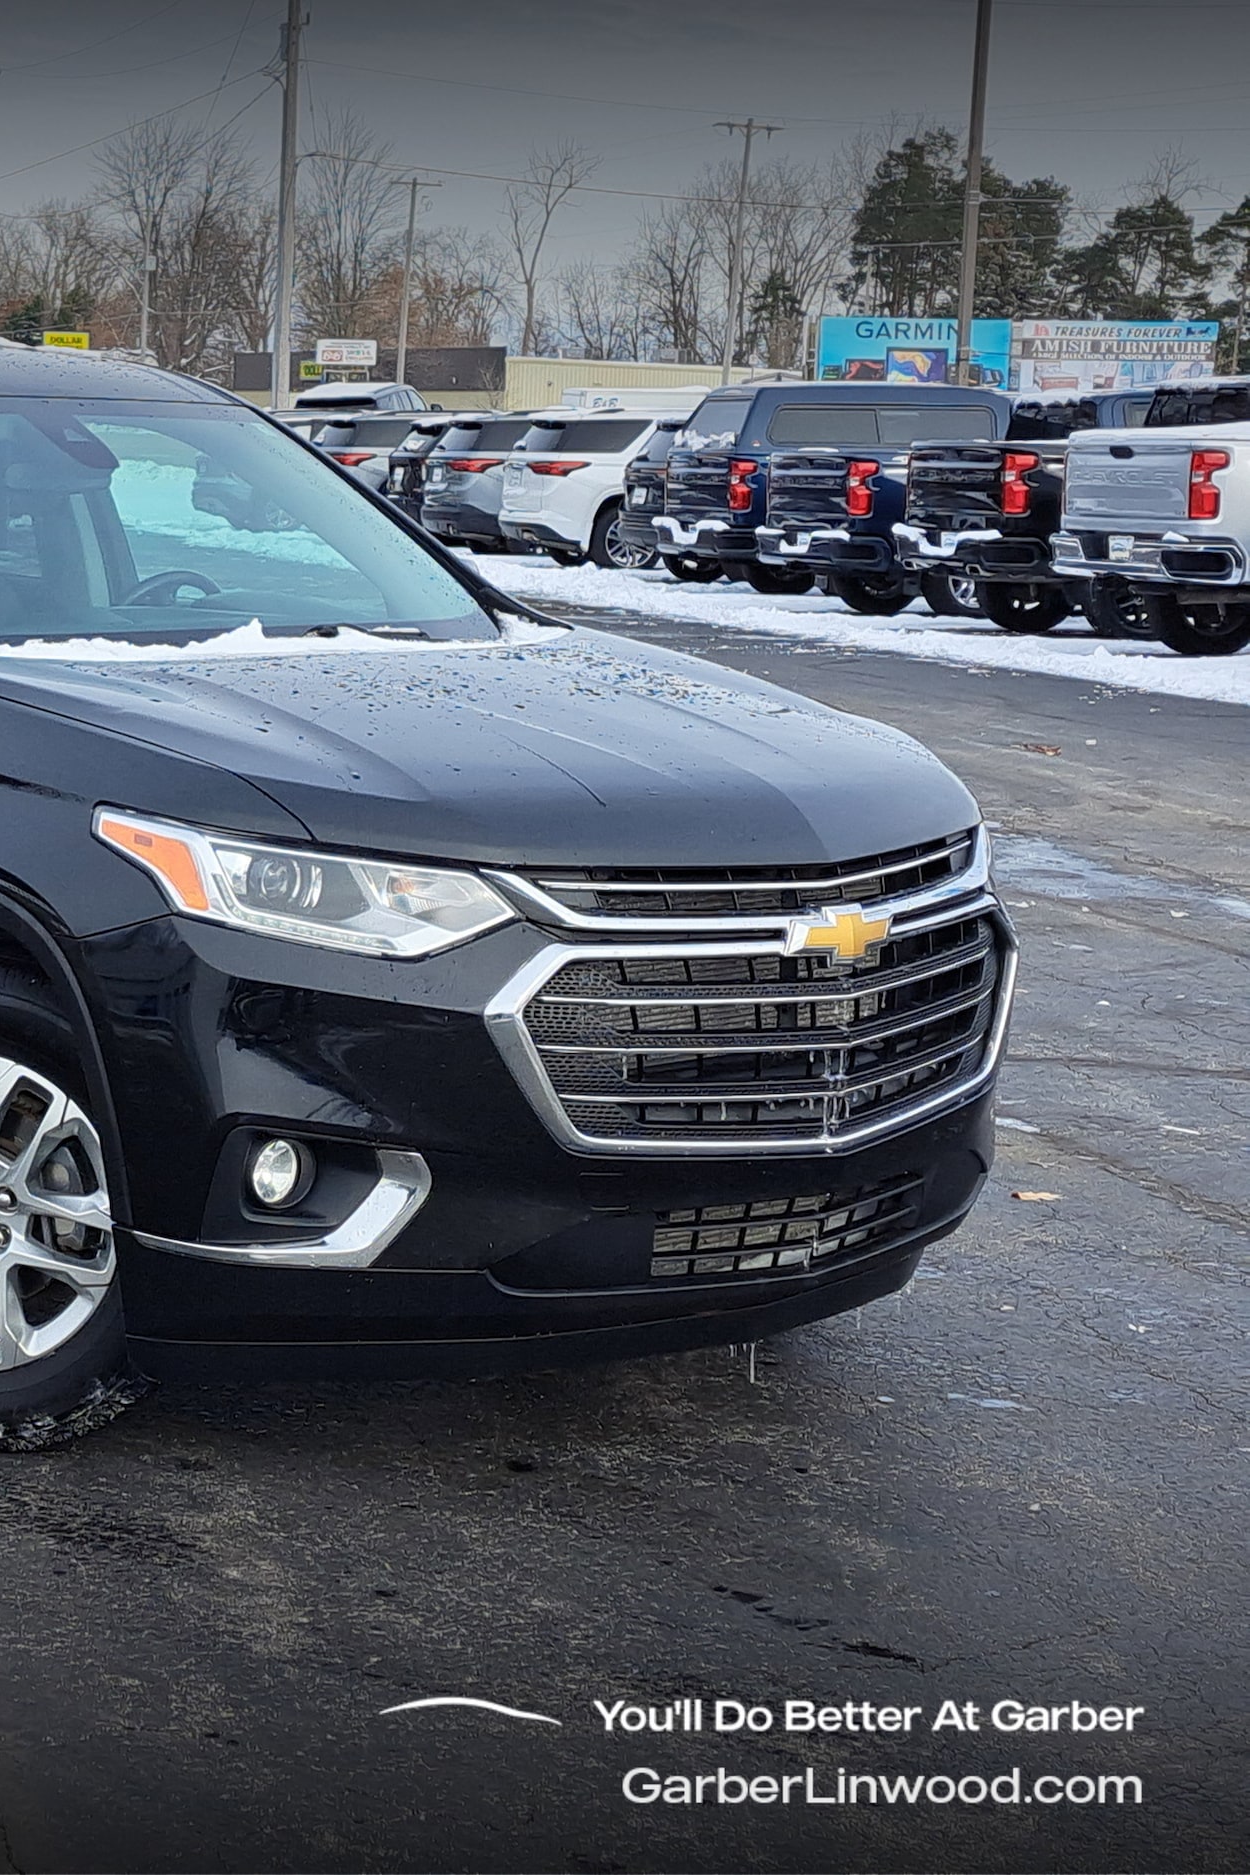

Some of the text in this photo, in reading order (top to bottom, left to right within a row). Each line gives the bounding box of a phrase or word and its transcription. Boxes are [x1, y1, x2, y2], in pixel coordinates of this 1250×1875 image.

[1054, 326, 1182, 338] TREASURES FOREVER
[50, 336, 83, 344] DOLLAR
[1031, 339, 1212, 354] AMISH FURNITURE
